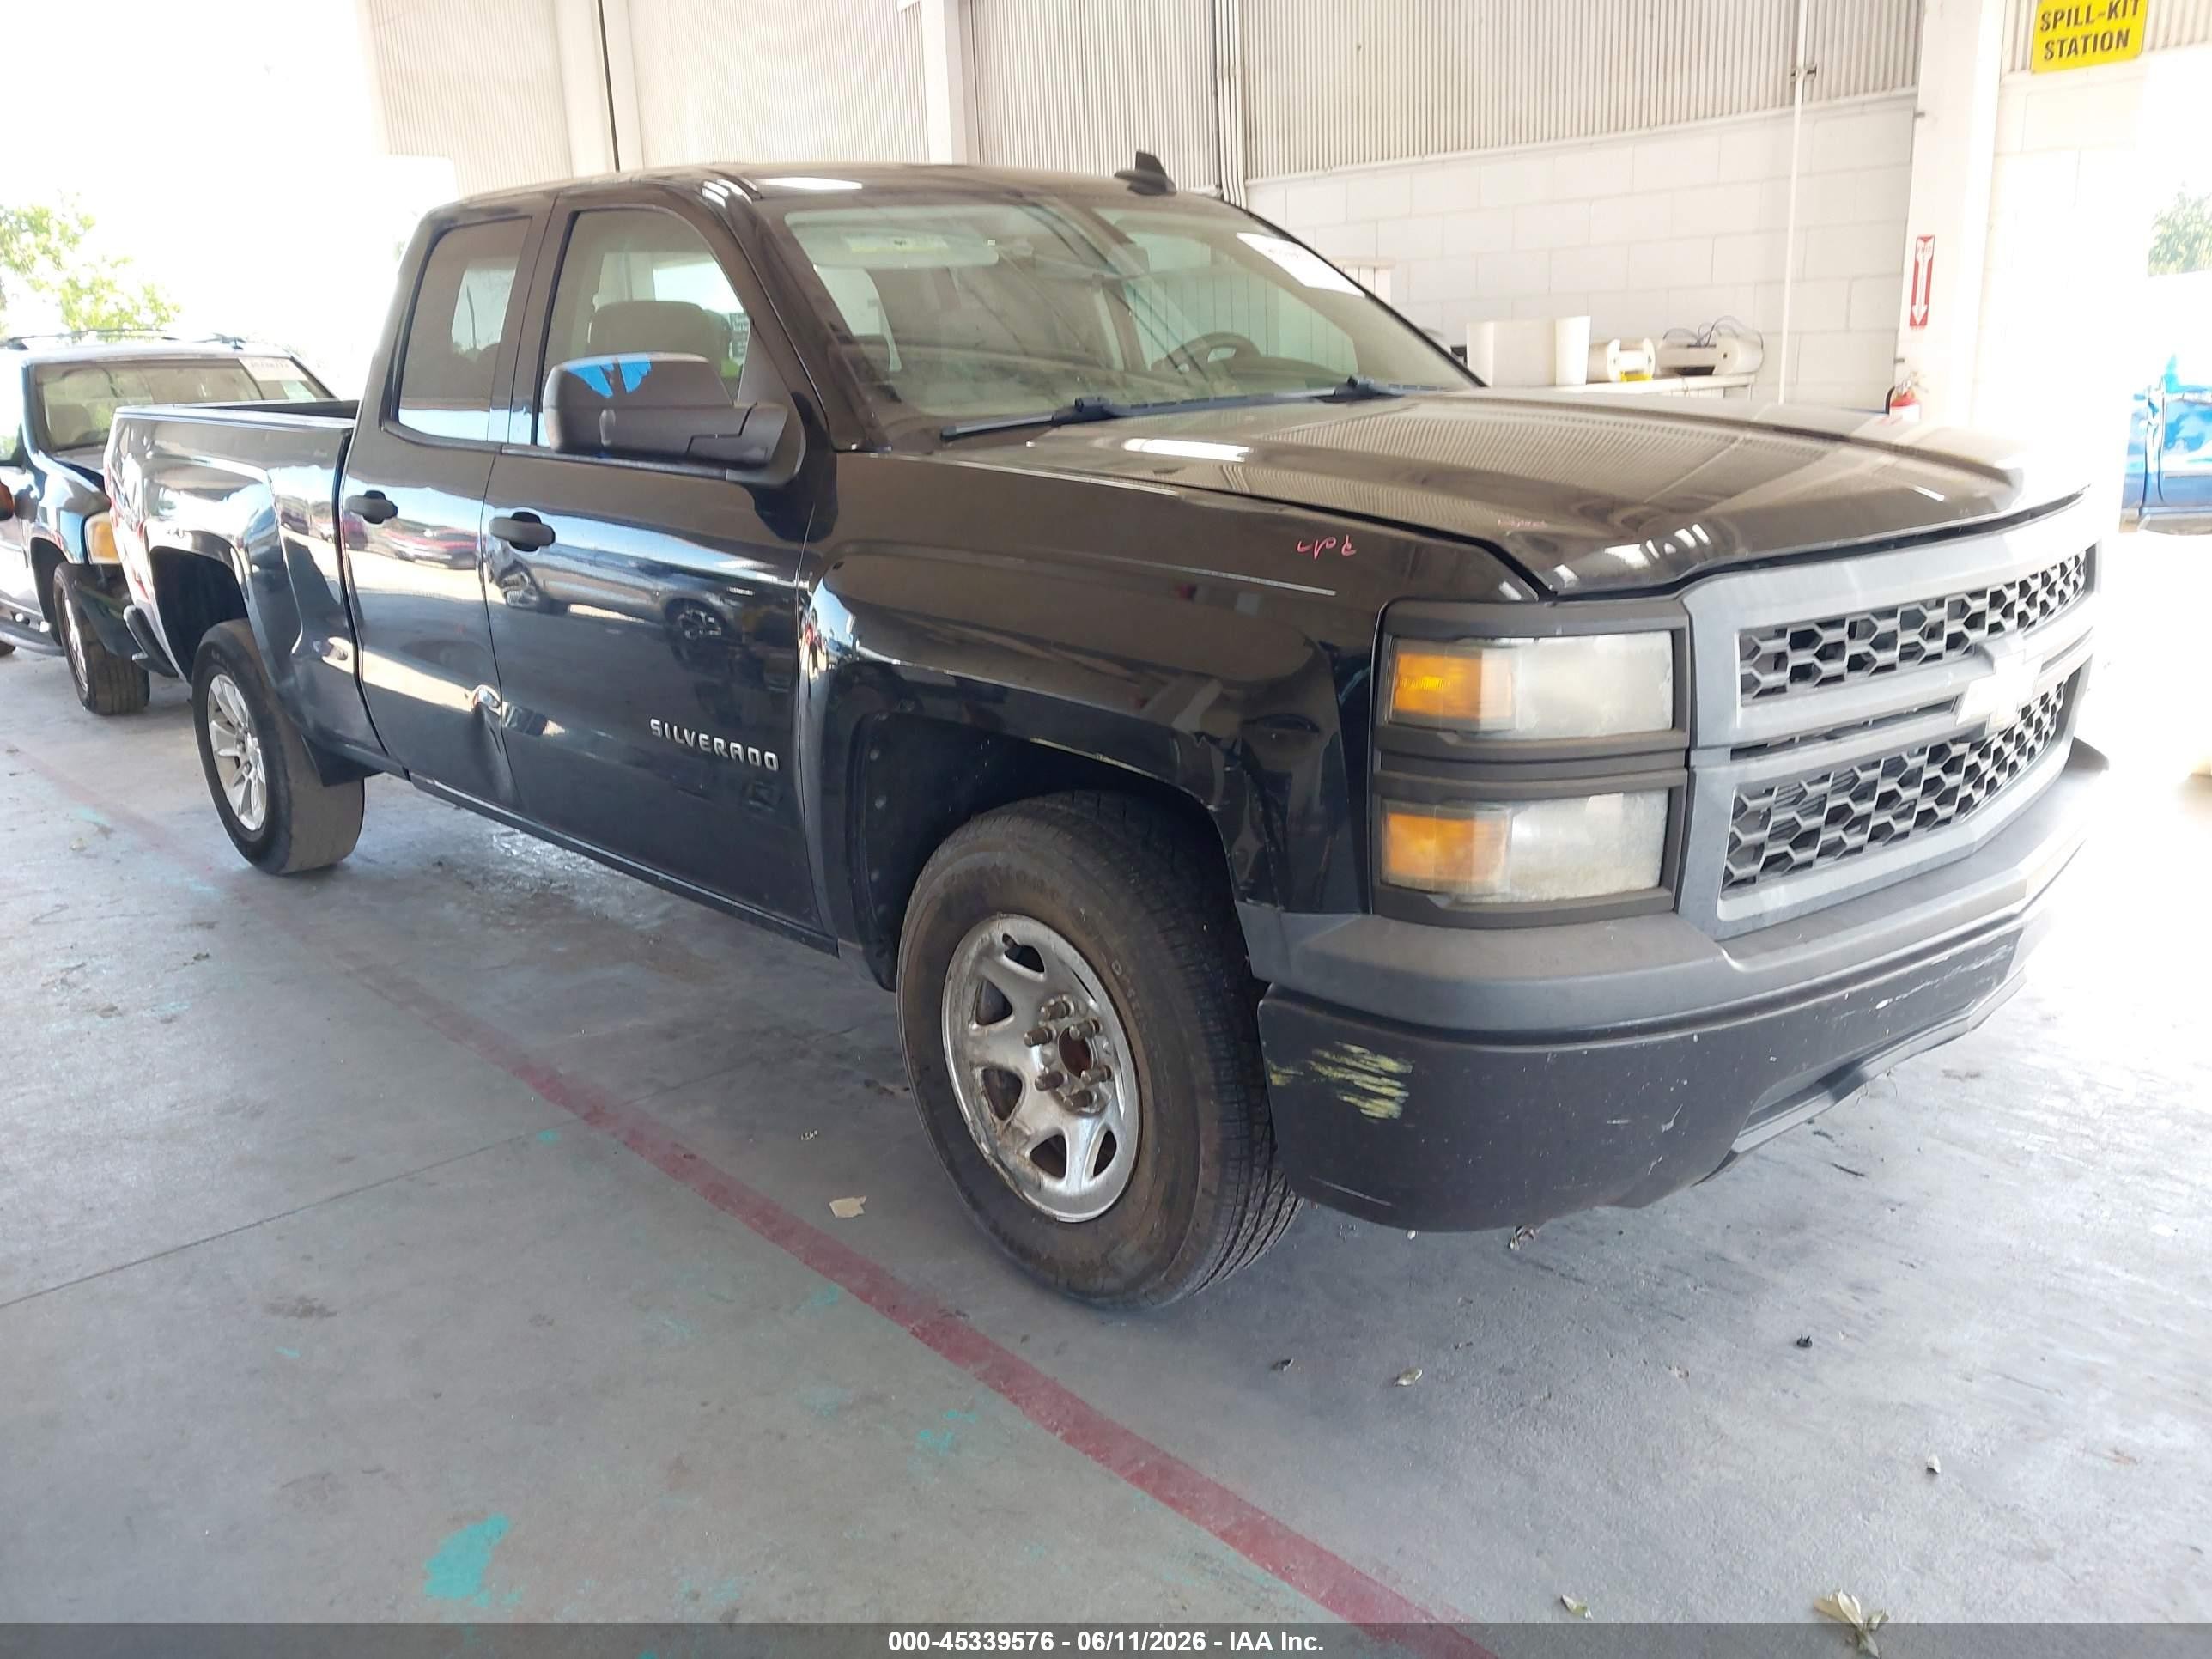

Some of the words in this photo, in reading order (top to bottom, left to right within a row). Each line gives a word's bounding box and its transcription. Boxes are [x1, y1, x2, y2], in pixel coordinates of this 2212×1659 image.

[2040, 0, 2140, 33] SPILL-KIT
[2044, 28, 2130, 61] STATION
[649, 717, 780, 772] SILVERADO
